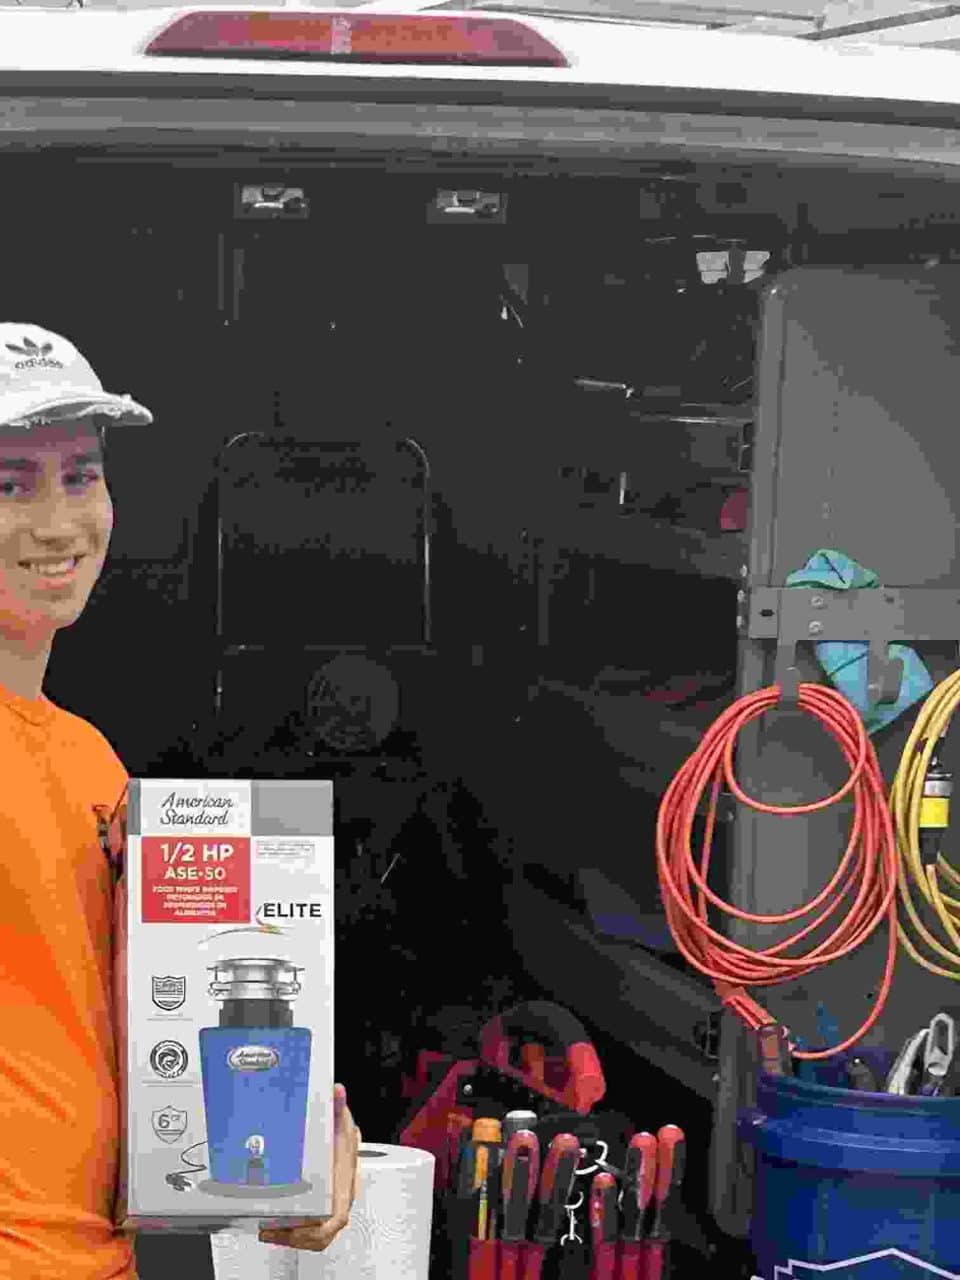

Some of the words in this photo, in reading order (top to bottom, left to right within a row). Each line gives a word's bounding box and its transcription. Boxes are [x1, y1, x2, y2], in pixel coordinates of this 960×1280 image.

[161, 792, 234, 809] American
[160, 809, 229, 826] Standard
[160, 843, 195, 864] 1/2
[203, 844, 234, 861] HP
[164, 866, 226, 880] ASE-50
[263, 902, 323, 918] ELITE
